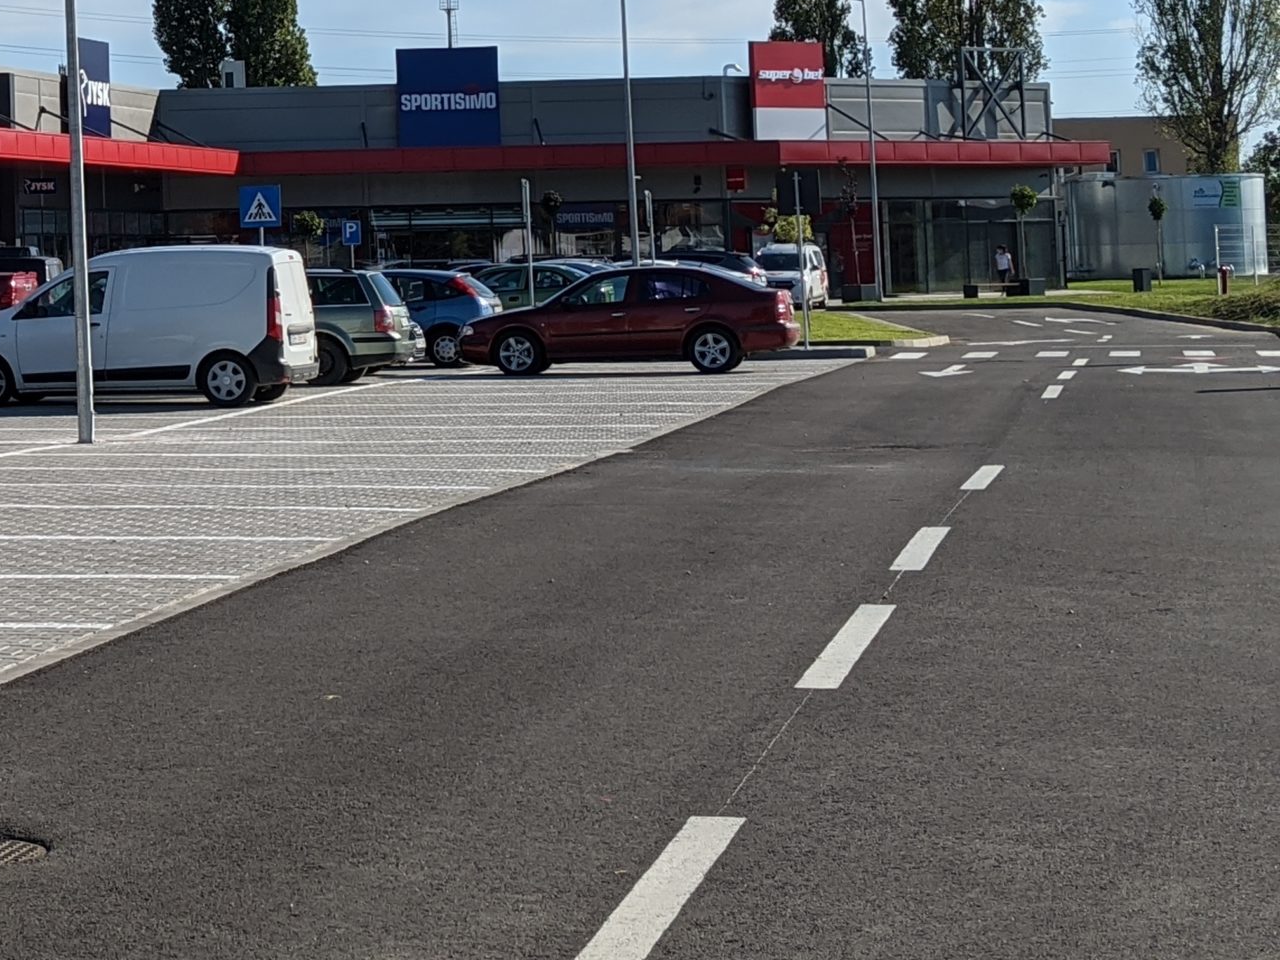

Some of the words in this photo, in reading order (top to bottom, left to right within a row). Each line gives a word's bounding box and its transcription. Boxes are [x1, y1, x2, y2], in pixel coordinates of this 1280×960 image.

[86, 80, 111, 107] JYSK
[30, 181, 55, 191] JYSK
[346, 222, 357, 238] P
